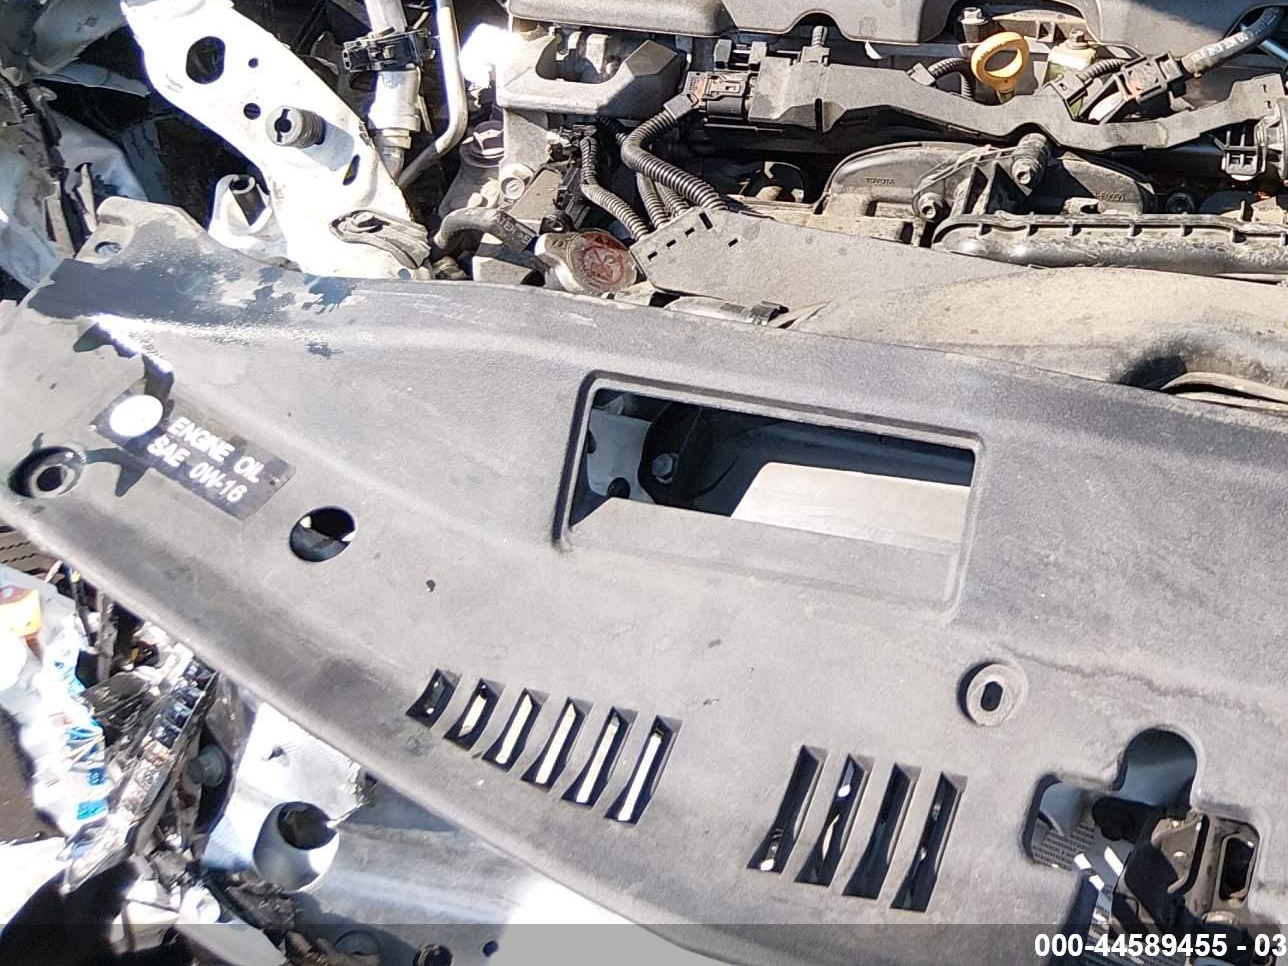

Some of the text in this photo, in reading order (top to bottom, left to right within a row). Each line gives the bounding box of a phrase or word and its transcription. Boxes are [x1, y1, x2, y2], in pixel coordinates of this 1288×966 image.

[865, 177, 896, 185] TOYOTA
[146, 434, 248, 503] SAE 0W-16
[166, 416, 265, 483] ENGINE OIL
